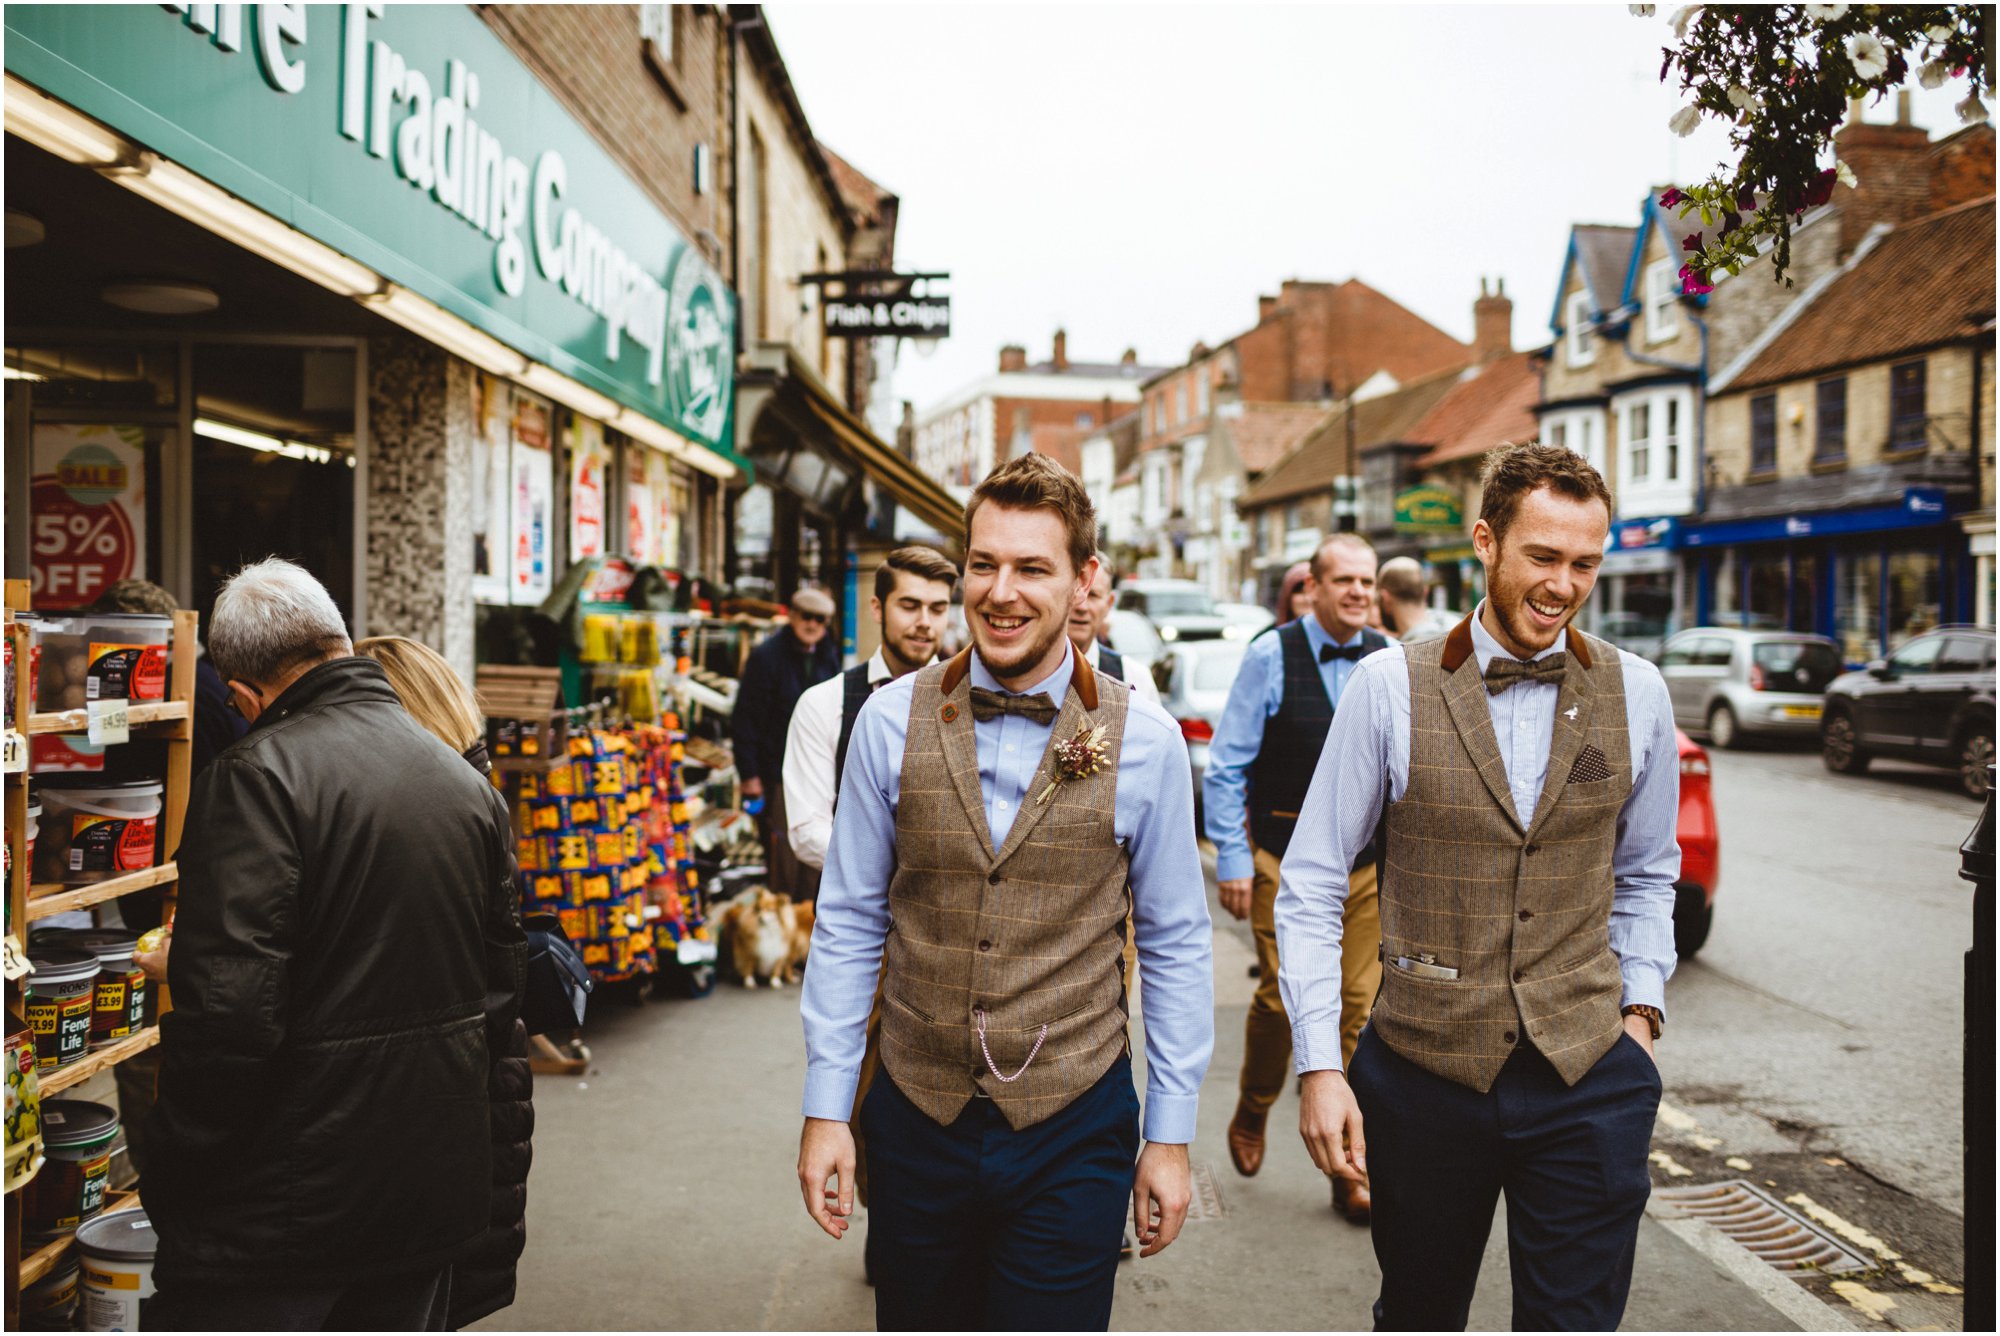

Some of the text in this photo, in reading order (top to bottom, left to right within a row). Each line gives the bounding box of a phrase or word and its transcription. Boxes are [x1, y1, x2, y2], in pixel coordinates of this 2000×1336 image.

[339, 4, 529, 298] Trading
[532, 150, 669, 386] Company
[826, 302, 949, 331] Fish & Chips
[61, 466, 123, 488] SALE
[103, 713, 127, 730] £4.99
[98, 986, 122, 994] NOW
[96, 996, 121, 1007] £3.99
[27, 1008, 56, 1017] NOW
[61, 1034, 82, 1051] Life
[13, 1142, 35, 1178] £1
